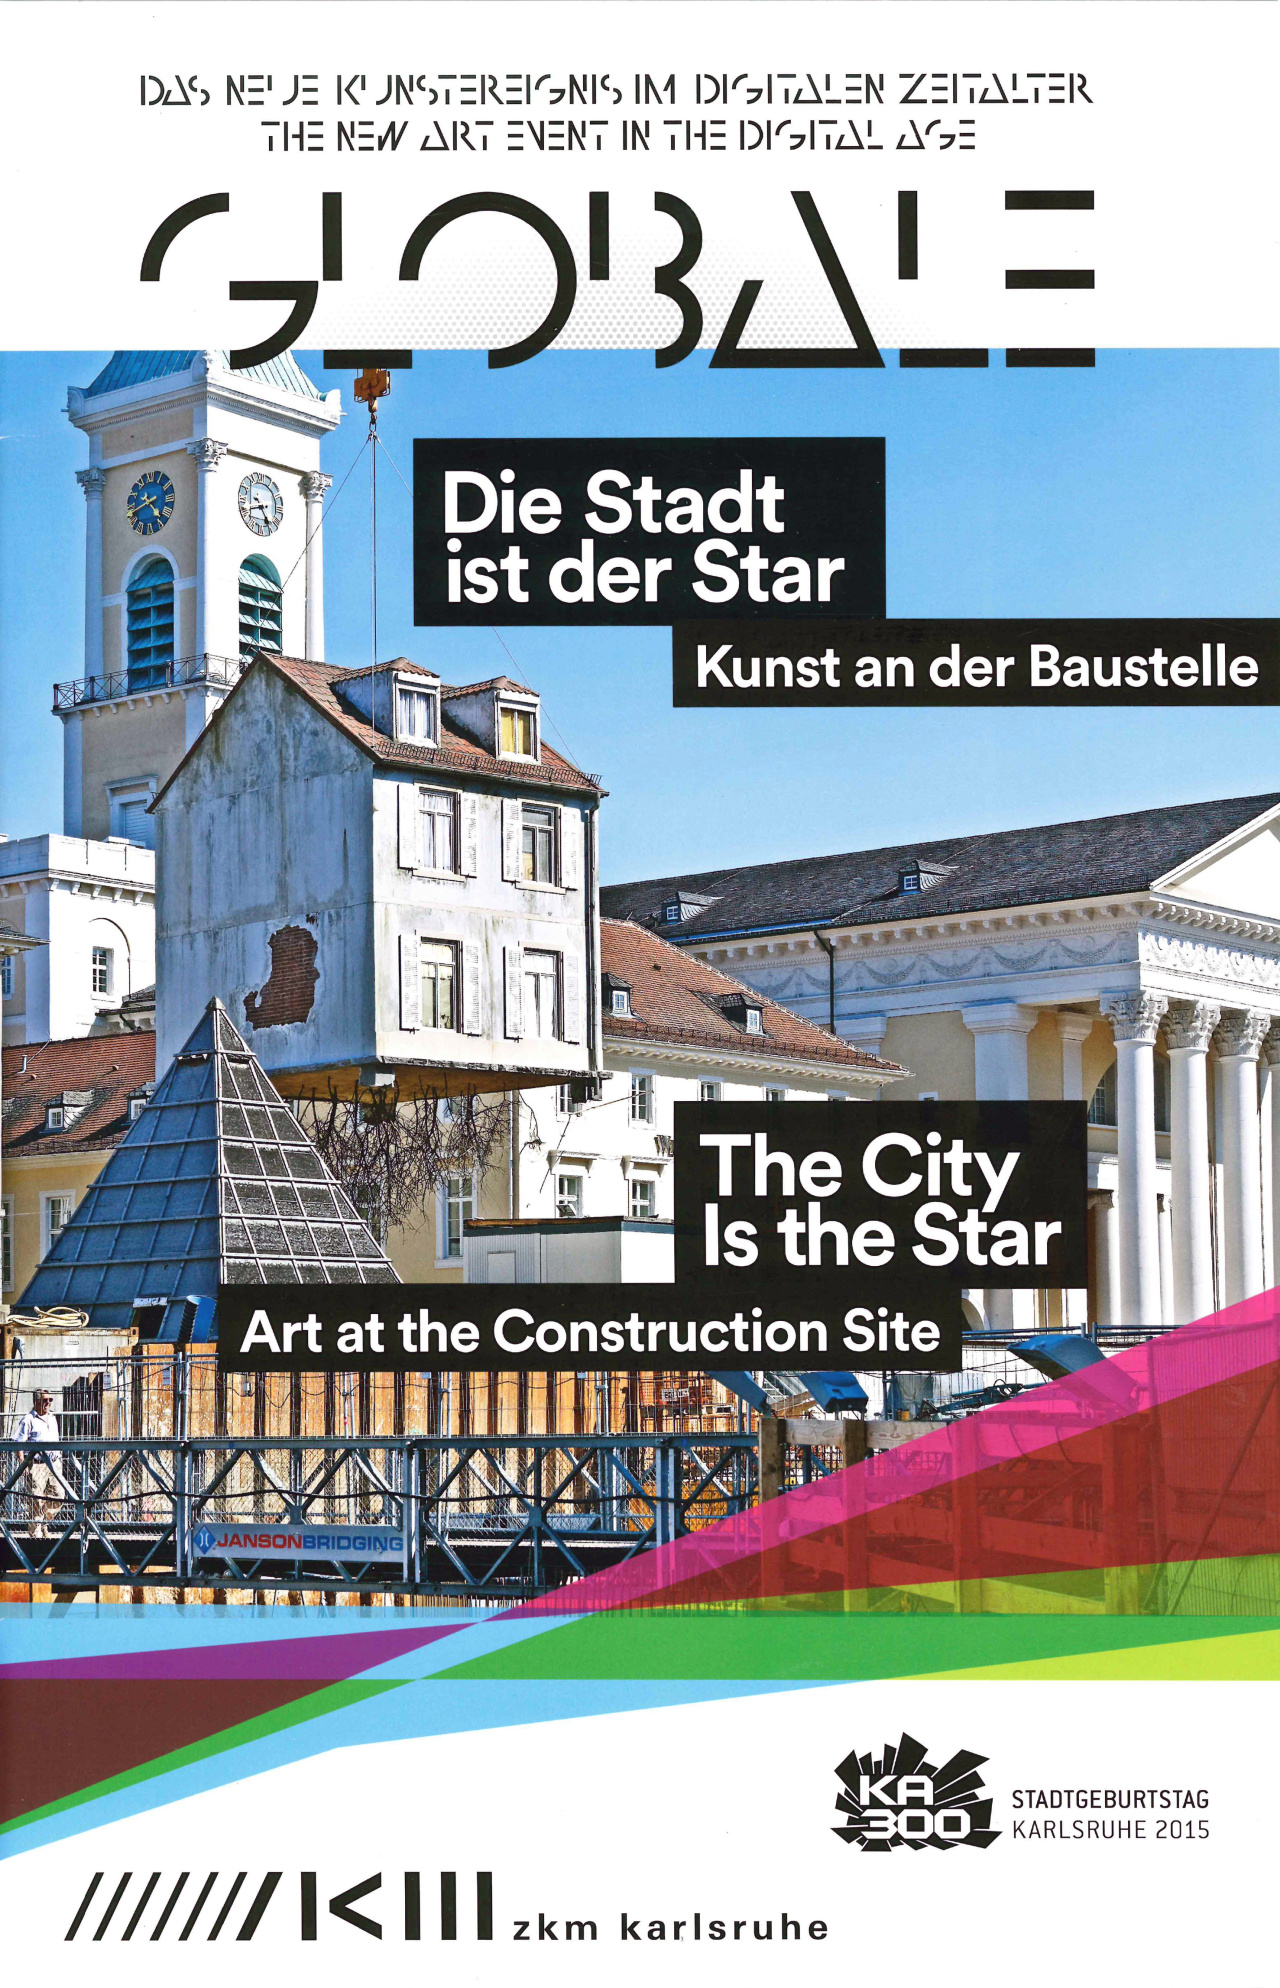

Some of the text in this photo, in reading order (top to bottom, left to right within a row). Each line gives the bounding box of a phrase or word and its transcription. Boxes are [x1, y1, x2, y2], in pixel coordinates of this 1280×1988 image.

[140, 73, 1094, 106] DAS NEUE KUNSTEREIGNIS IM DIGITALEN ZEITALTER
[261, 119, 976, 152] THE NEW ART EVENT IN THE DIGITAL AGE
[140, 190, 1096, 369] GLOBALE
[444, 468, 785, 535] Die Stadt
[446, 537, 845, 604] ist der Star
[697, 642, 1259, 689] Kunst an der Baustelle
[699, 1131, 1021, 1213] The City
[705, 1201, 1062, 1267] Is the Star
[239, 1306, 941, 1354] Art at the Construction Site
[859, 1774, 934, 1806] KA
[1012, 1789, 1209, 1809] STADTGEBURTSTAG
[860, 1808, 971, 1840] 300
[1013, 1819, 1210, 1839] KARLSRUHE 2015
[513, 1912, 828, 1941] zkm karlsruhe
